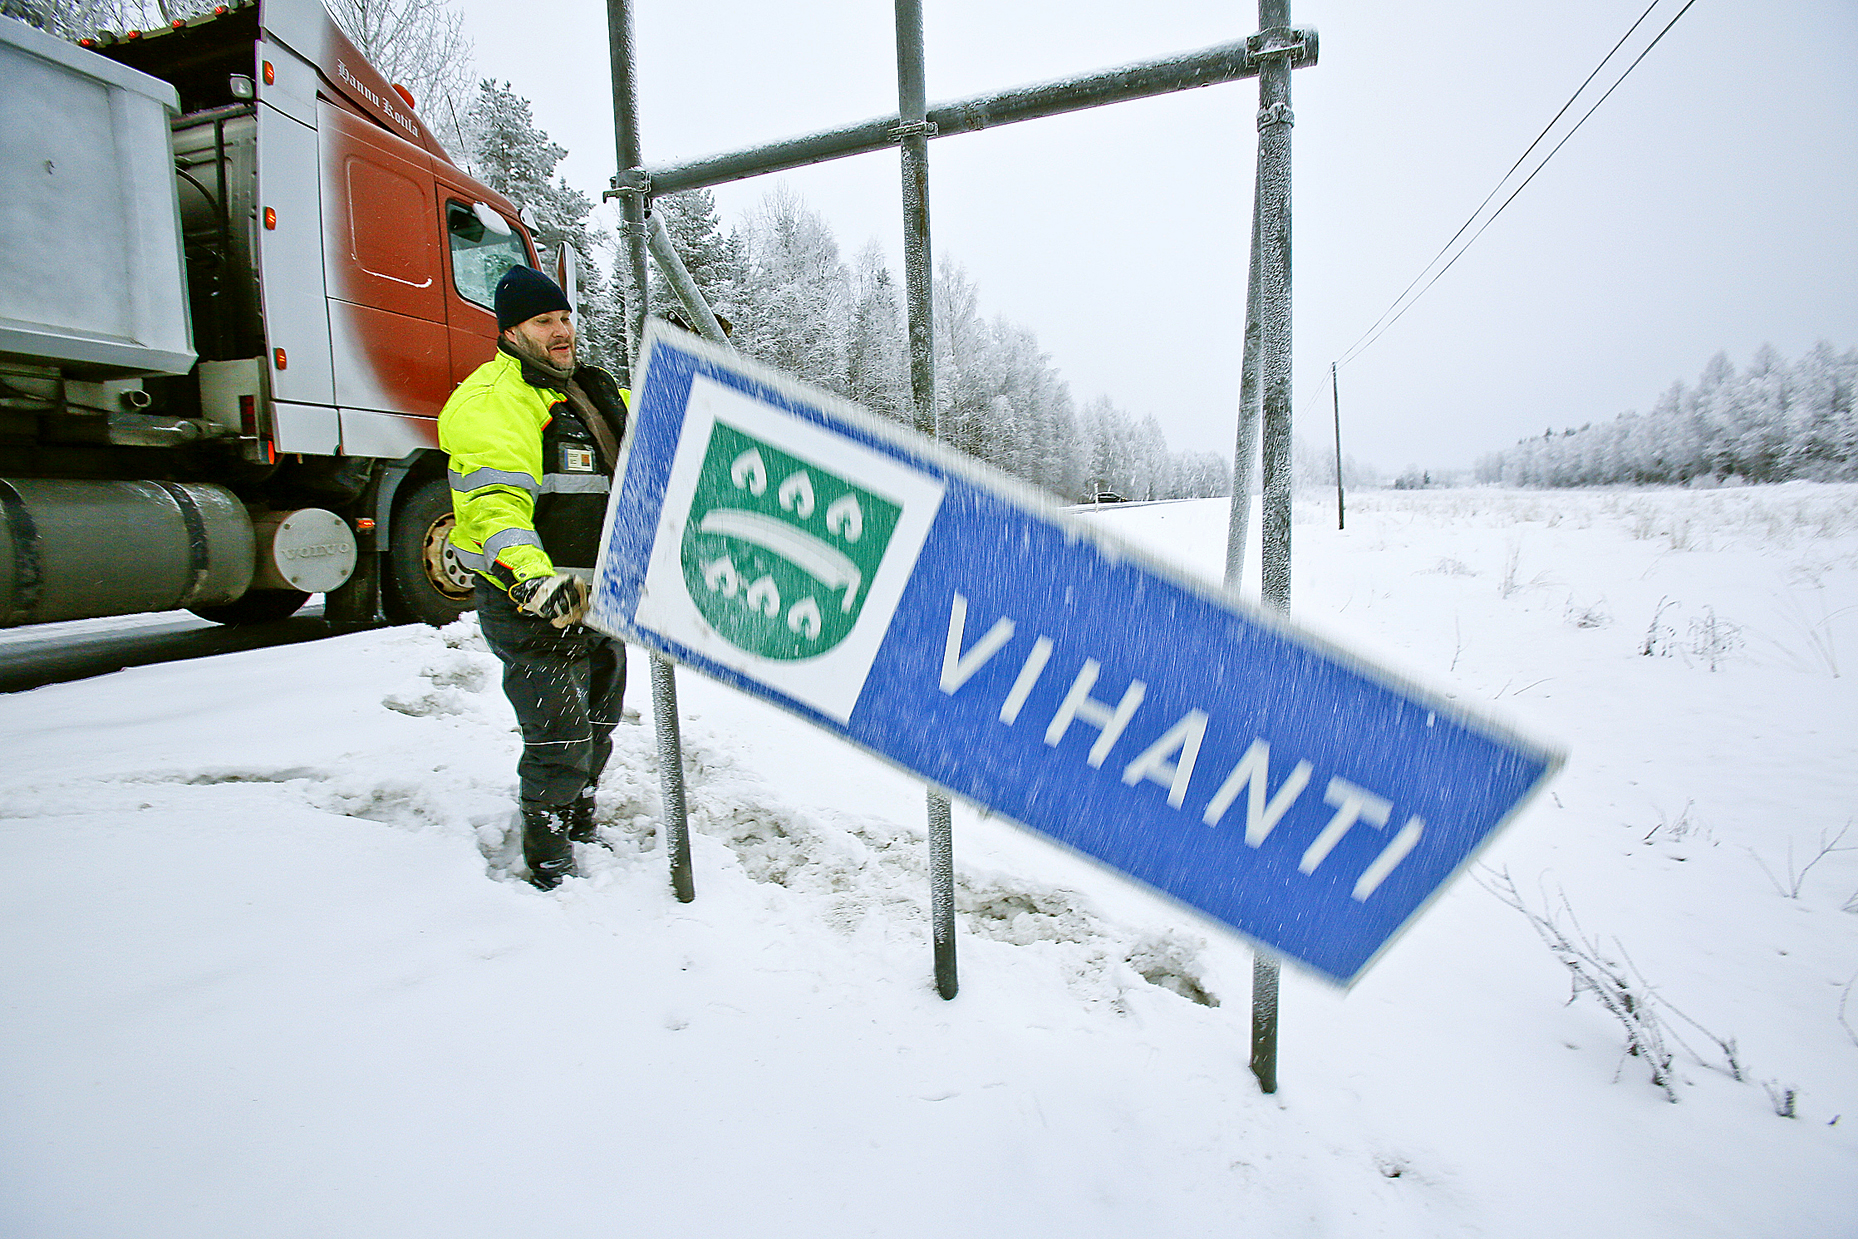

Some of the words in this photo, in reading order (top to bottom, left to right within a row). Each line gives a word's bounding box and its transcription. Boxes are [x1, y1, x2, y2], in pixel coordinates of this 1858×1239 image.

[337, 59, 380, 108] Hannu
[281, 543, 350, 560] VOLVO
[938, 590, 1427, 903] VIHANTI
